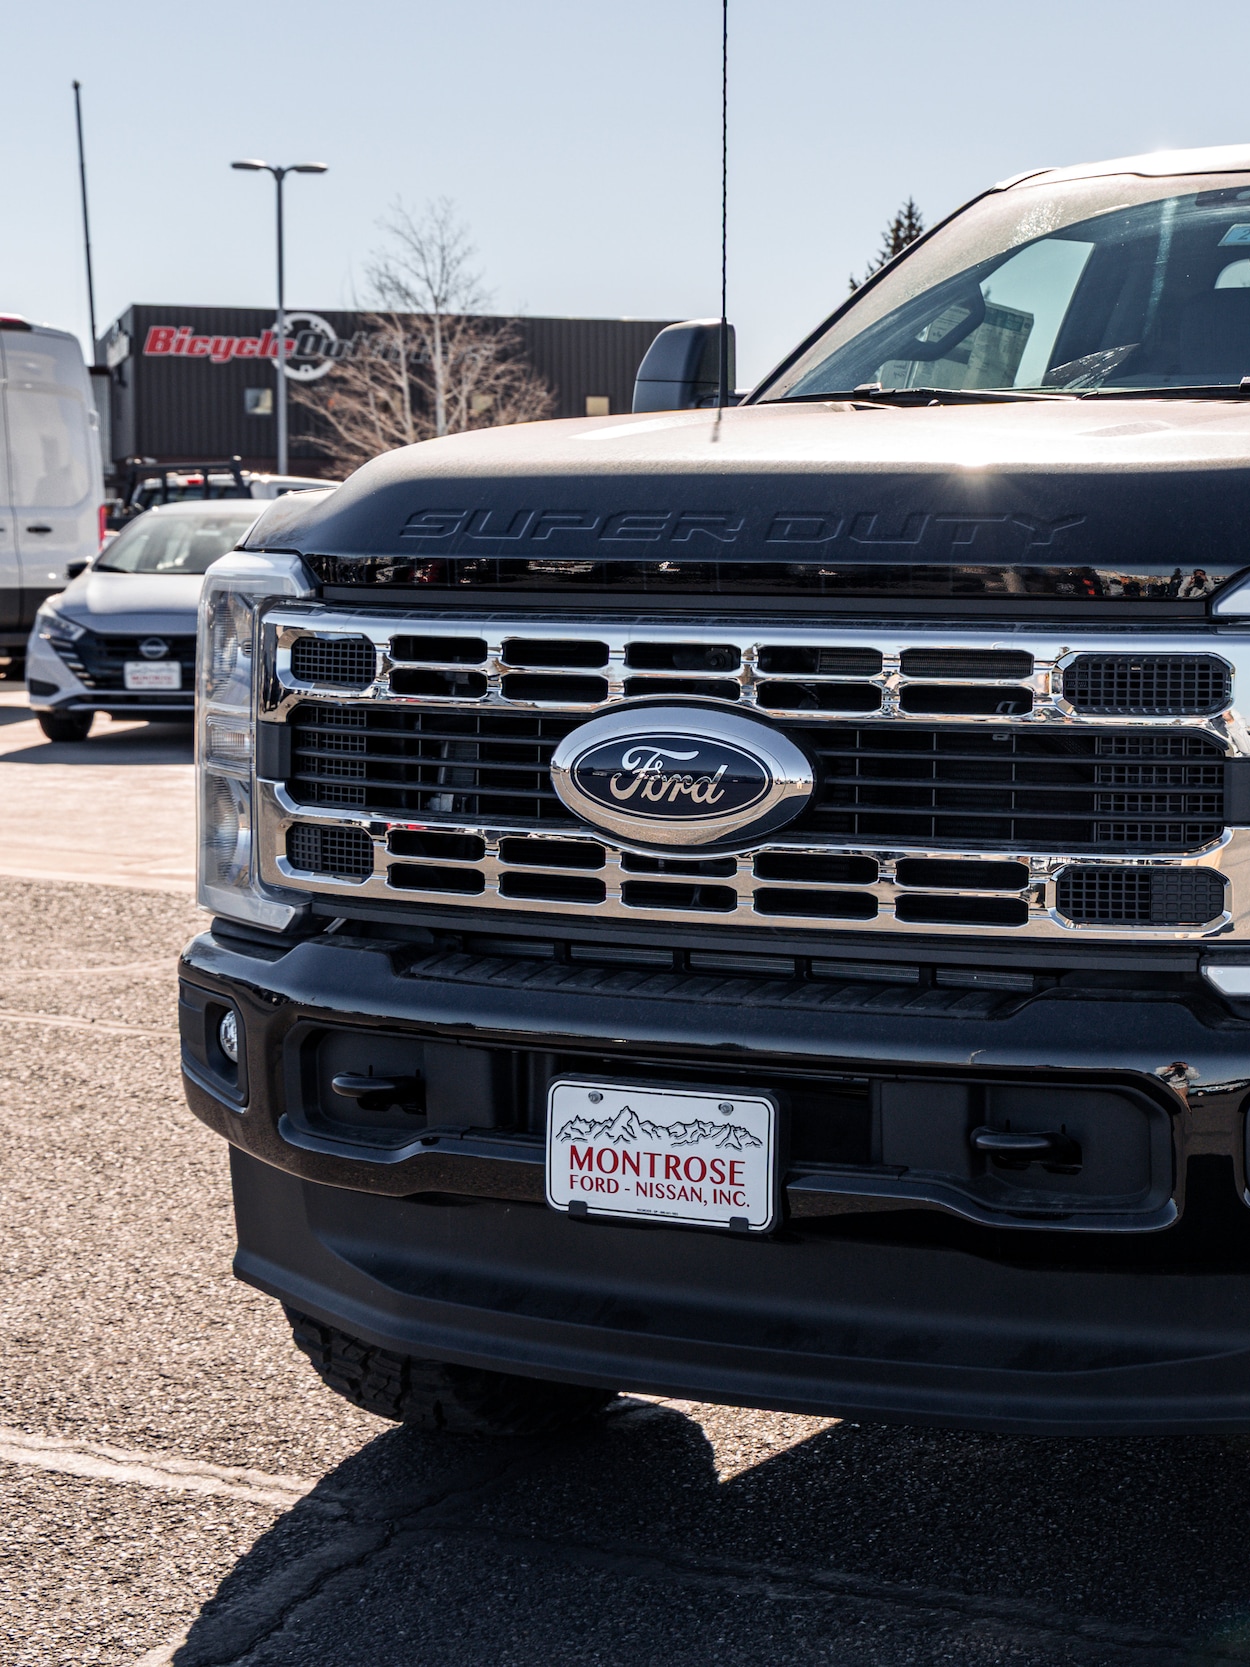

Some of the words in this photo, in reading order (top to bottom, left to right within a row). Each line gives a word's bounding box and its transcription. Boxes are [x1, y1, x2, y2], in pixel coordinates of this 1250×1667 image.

[143, 325, 297, 363] Bicycle
[400, 508, 745, 542] SUPER
[764, 510, 1088, 545] DUTY
[609, 745, 729, 805] Ford
[569, 1144, 746, 1187] MONTROSE
[569, 1174, 619, 1194] FORD
[635, 1180, 708, 1206] NISSAN,
[712, 1188, 750, 1208] INC.
